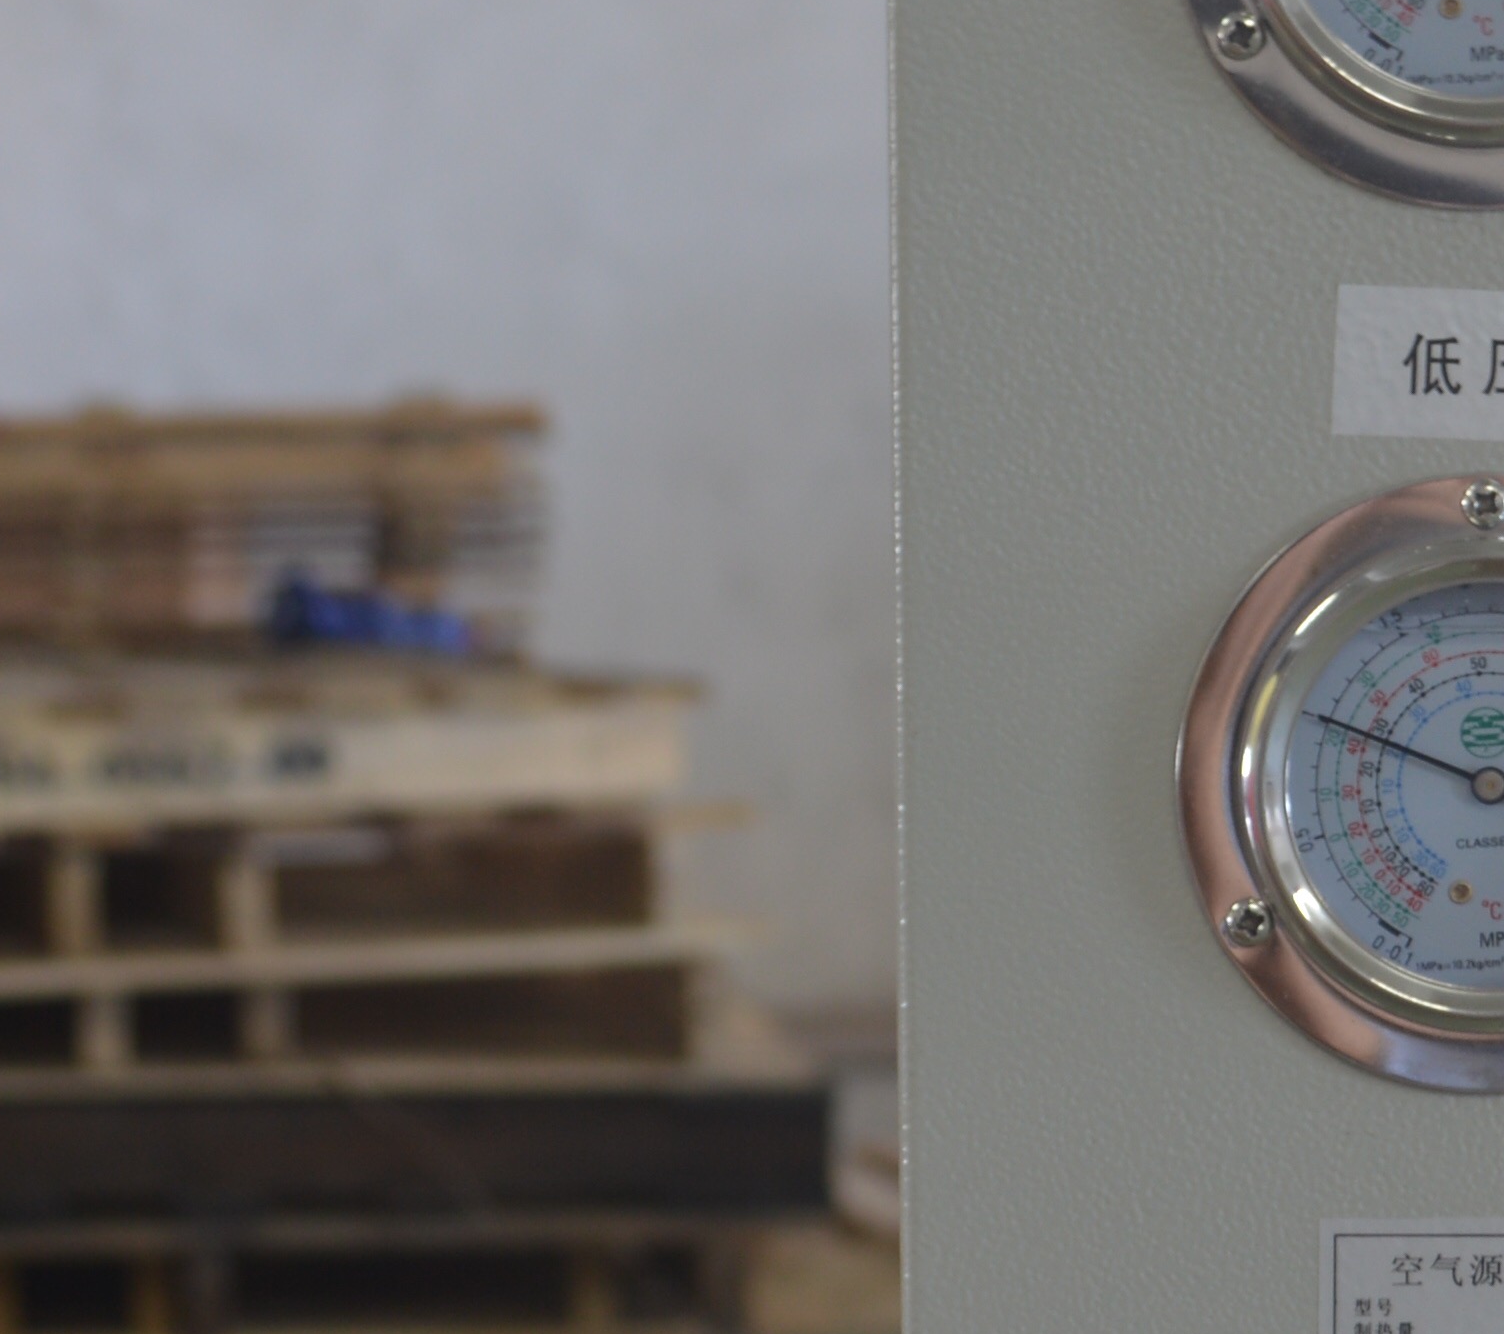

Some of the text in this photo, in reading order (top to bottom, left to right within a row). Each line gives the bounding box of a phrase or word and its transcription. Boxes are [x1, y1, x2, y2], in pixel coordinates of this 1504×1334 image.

[1470, 46, 1504, 61] MPa
[1470, 656, 1487, 670] 50
[1408, 678, 1425, 694] 40
[1456, 680, 1471, 692] 40
[1372, 719, 1389, 734] 30
[1347, 739, 1361, 755] 40
[1361, 761, 1374, 778] 20
[1342, 785, 1355, 800] 30
[1382, 779, 1394, 794] 10
[1319, 789, 1332, 801] 10
[1362, 799, 1375, 814] 10
[1386, 810, 1398, 818] 0
[1348, 822, 1364, 838] 20
[1371, 829, 1382, 838] 0
[1330, 834, 1341, 842] 0
[1360, 848, 1376, 865] 10
[1380, 846, 1396, 862] -10
[1375, 869, 1385, 880] 0
[1372, 935, 1384, 949] 0
[1383, 944, 1413, 965] -0.1
[1354, 1298, 1392, 1317] 型号
